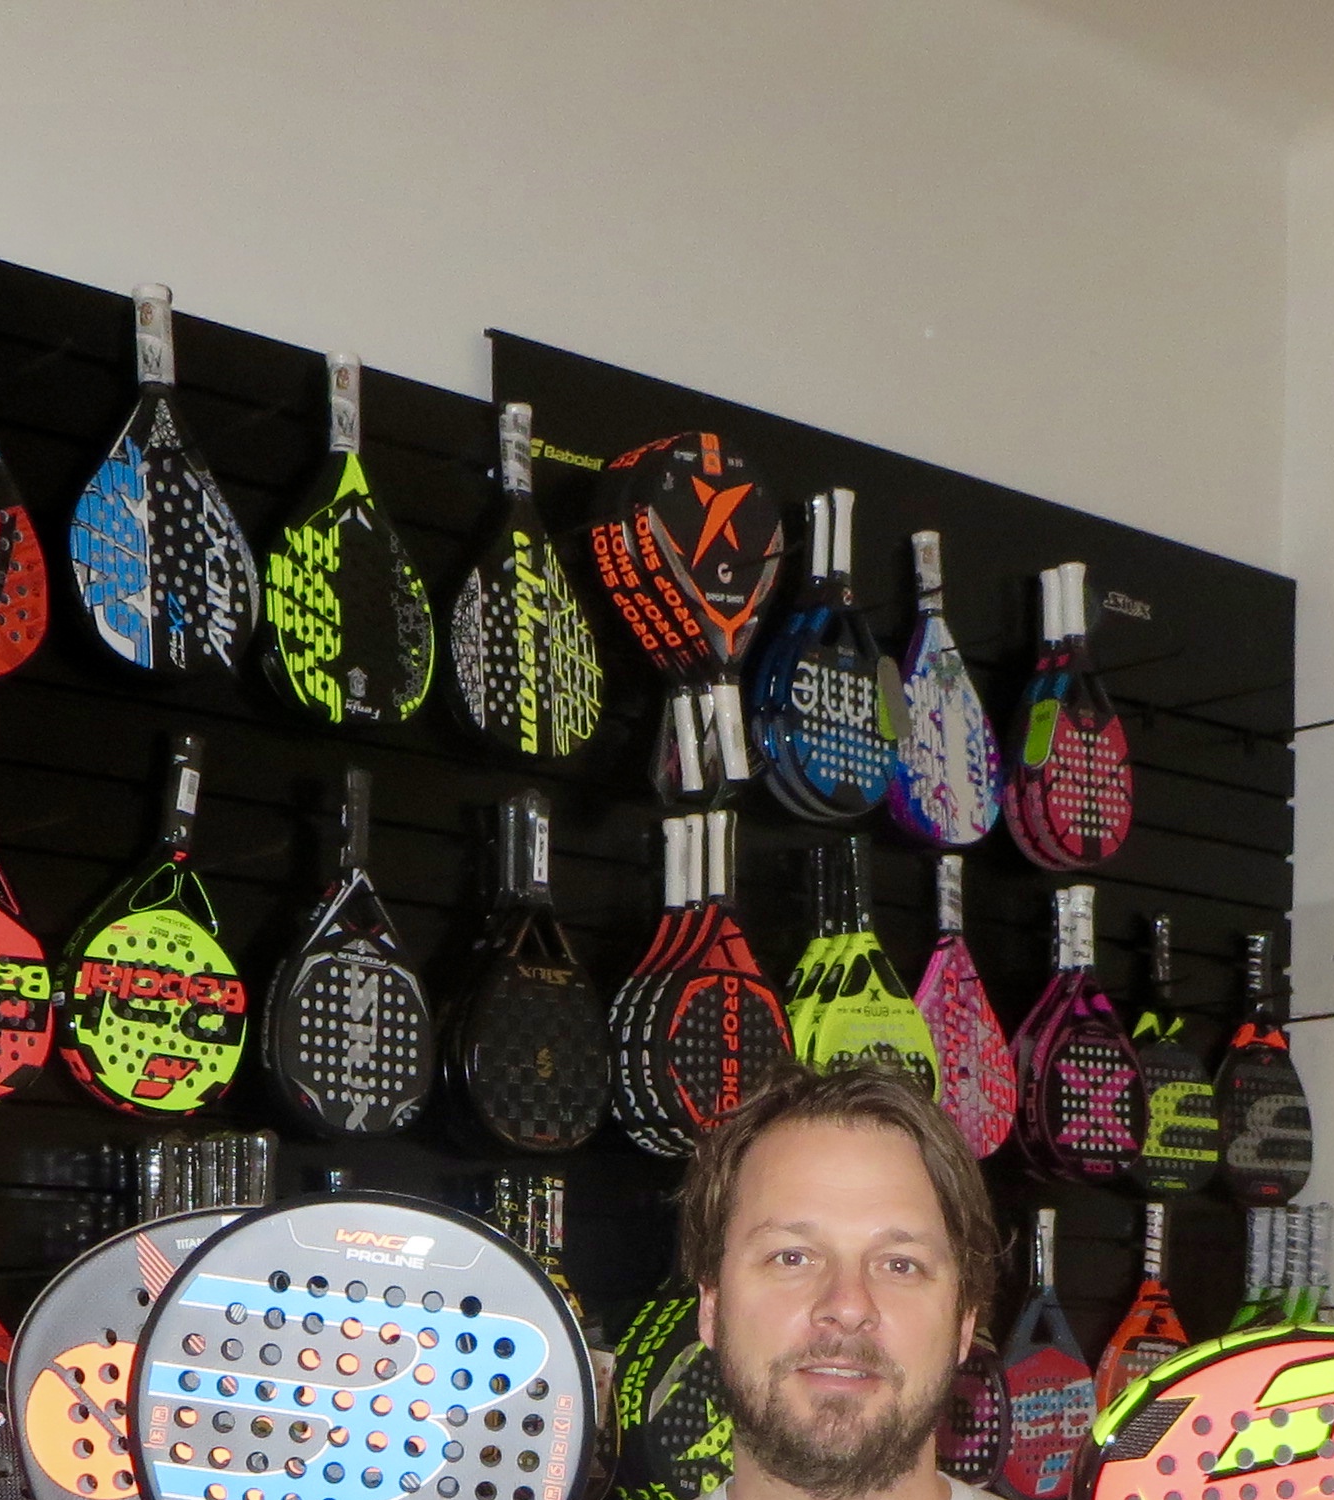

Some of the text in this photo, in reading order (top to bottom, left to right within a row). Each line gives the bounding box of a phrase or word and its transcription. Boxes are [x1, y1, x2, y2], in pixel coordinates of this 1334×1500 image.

[73, 961, 246, 1015] Babolat
[722, 976, 739, 1051] DROP
[334, 1228, 408, 1250] WING
[345, 1248, 425, 1270] PROLINE
